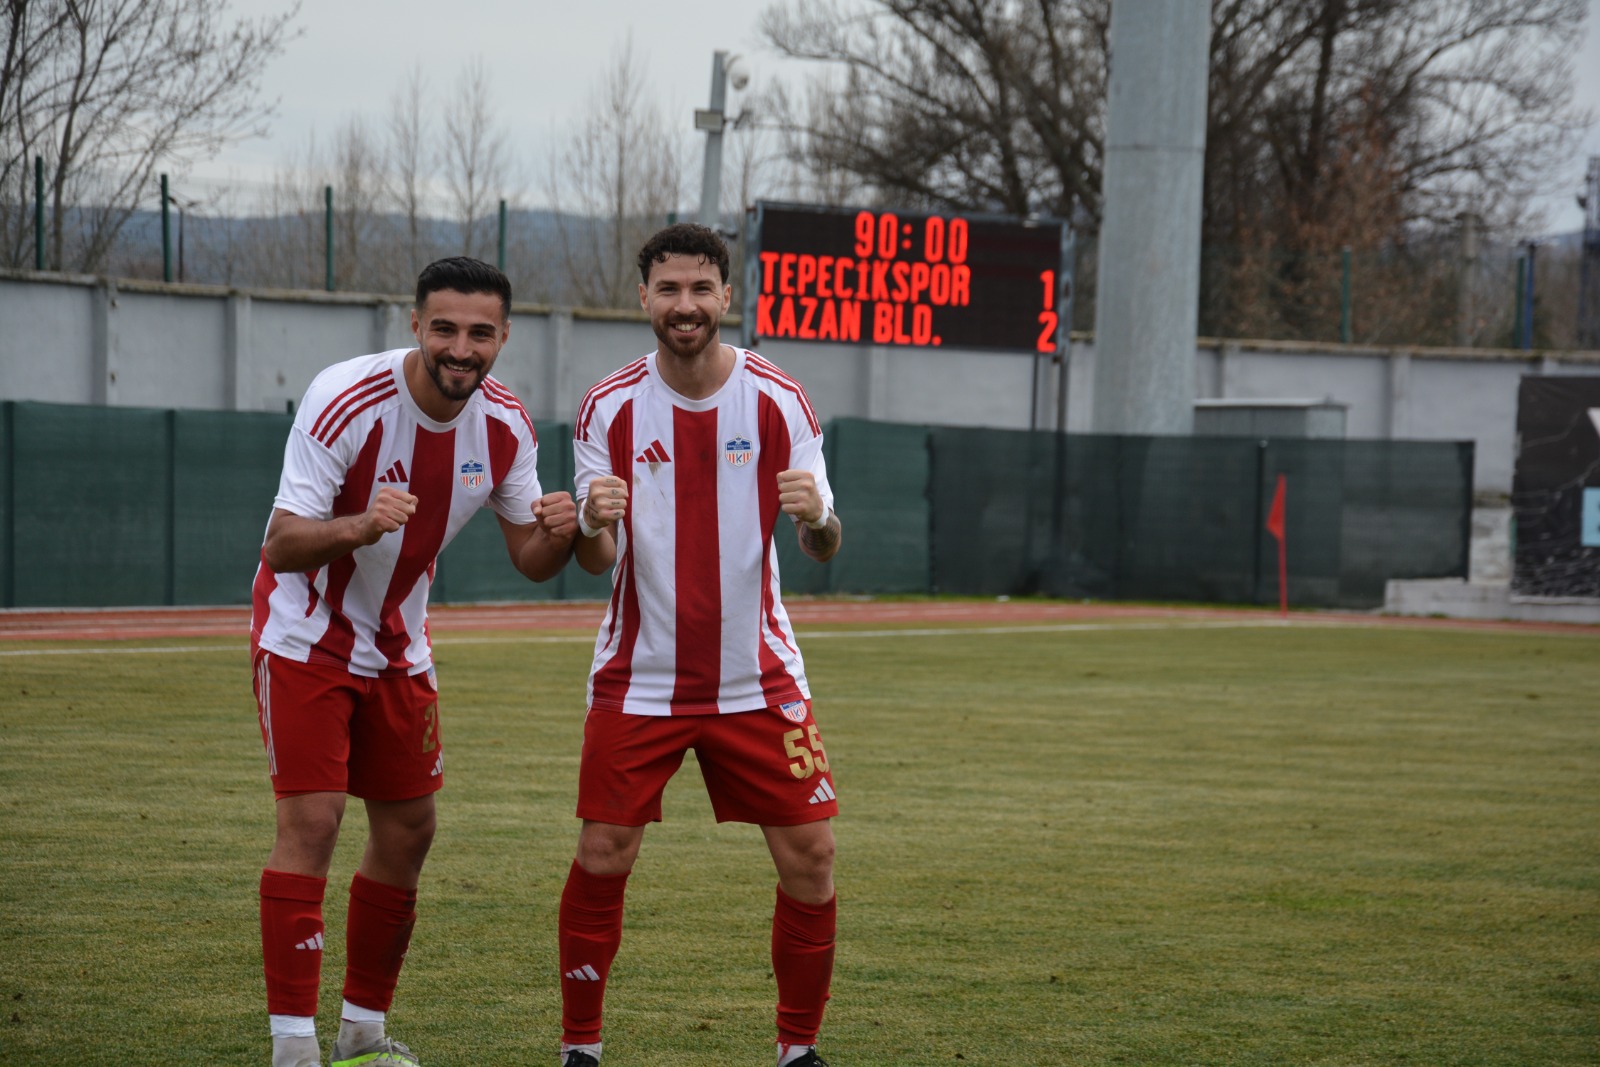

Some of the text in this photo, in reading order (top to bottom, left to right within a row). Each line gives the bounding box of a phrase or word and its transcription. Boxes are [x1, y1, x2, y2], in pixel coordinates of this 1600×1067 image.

[1039, 269, 1055, 311] 1
[755, 293, 1058, 353] KAZAN BLD. 2
[783, 724, 830, 779] 55
